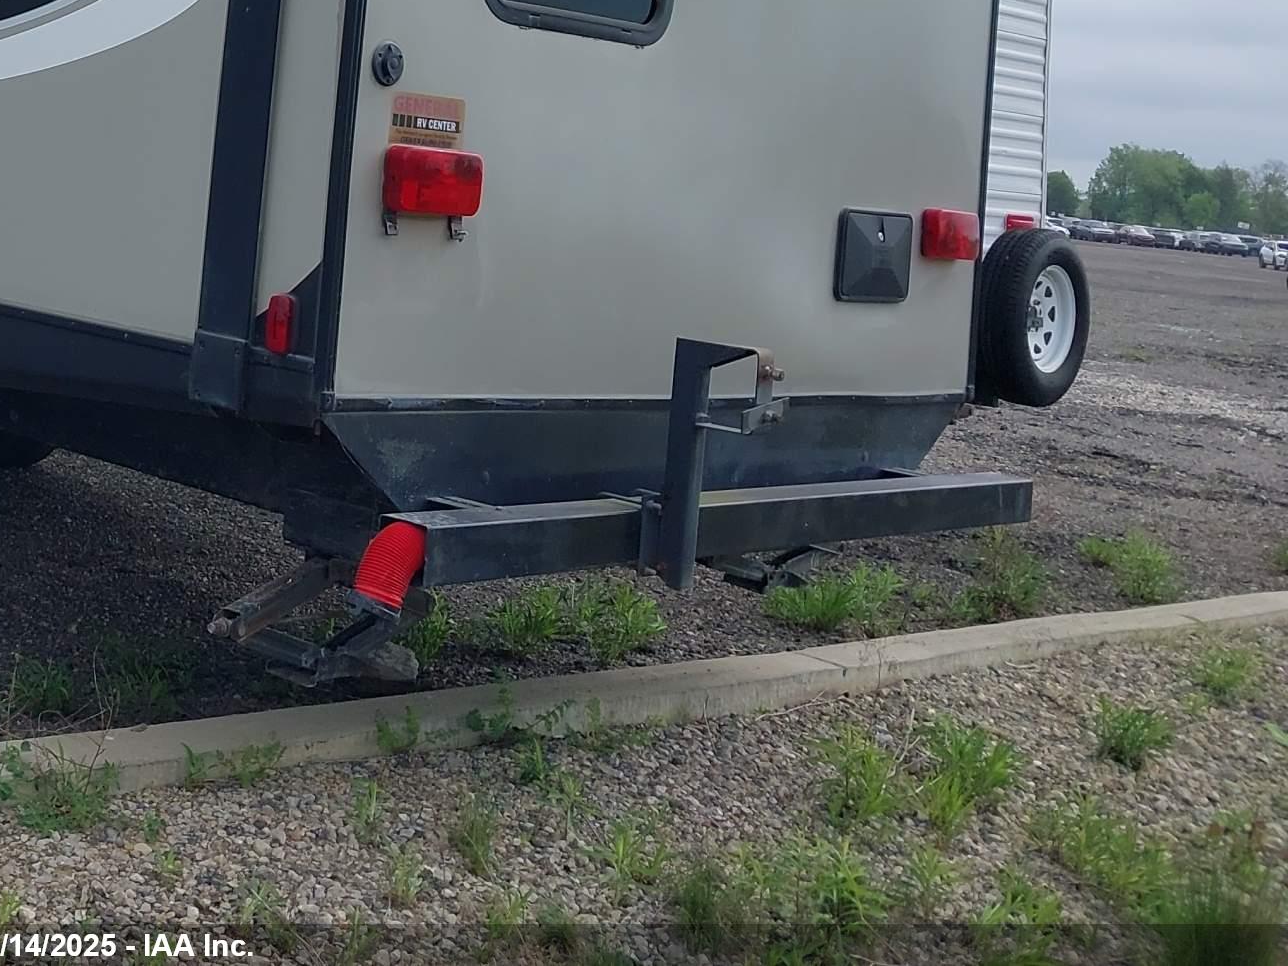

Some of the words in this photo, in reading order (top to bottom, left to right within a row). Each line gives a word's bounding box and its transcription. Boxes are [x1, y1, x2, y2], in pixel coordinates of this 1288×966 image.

[394, 95, 458, 119] GENER
[416, 117, 428, 129] RV
[428, 119, 457, 132] CENTER
